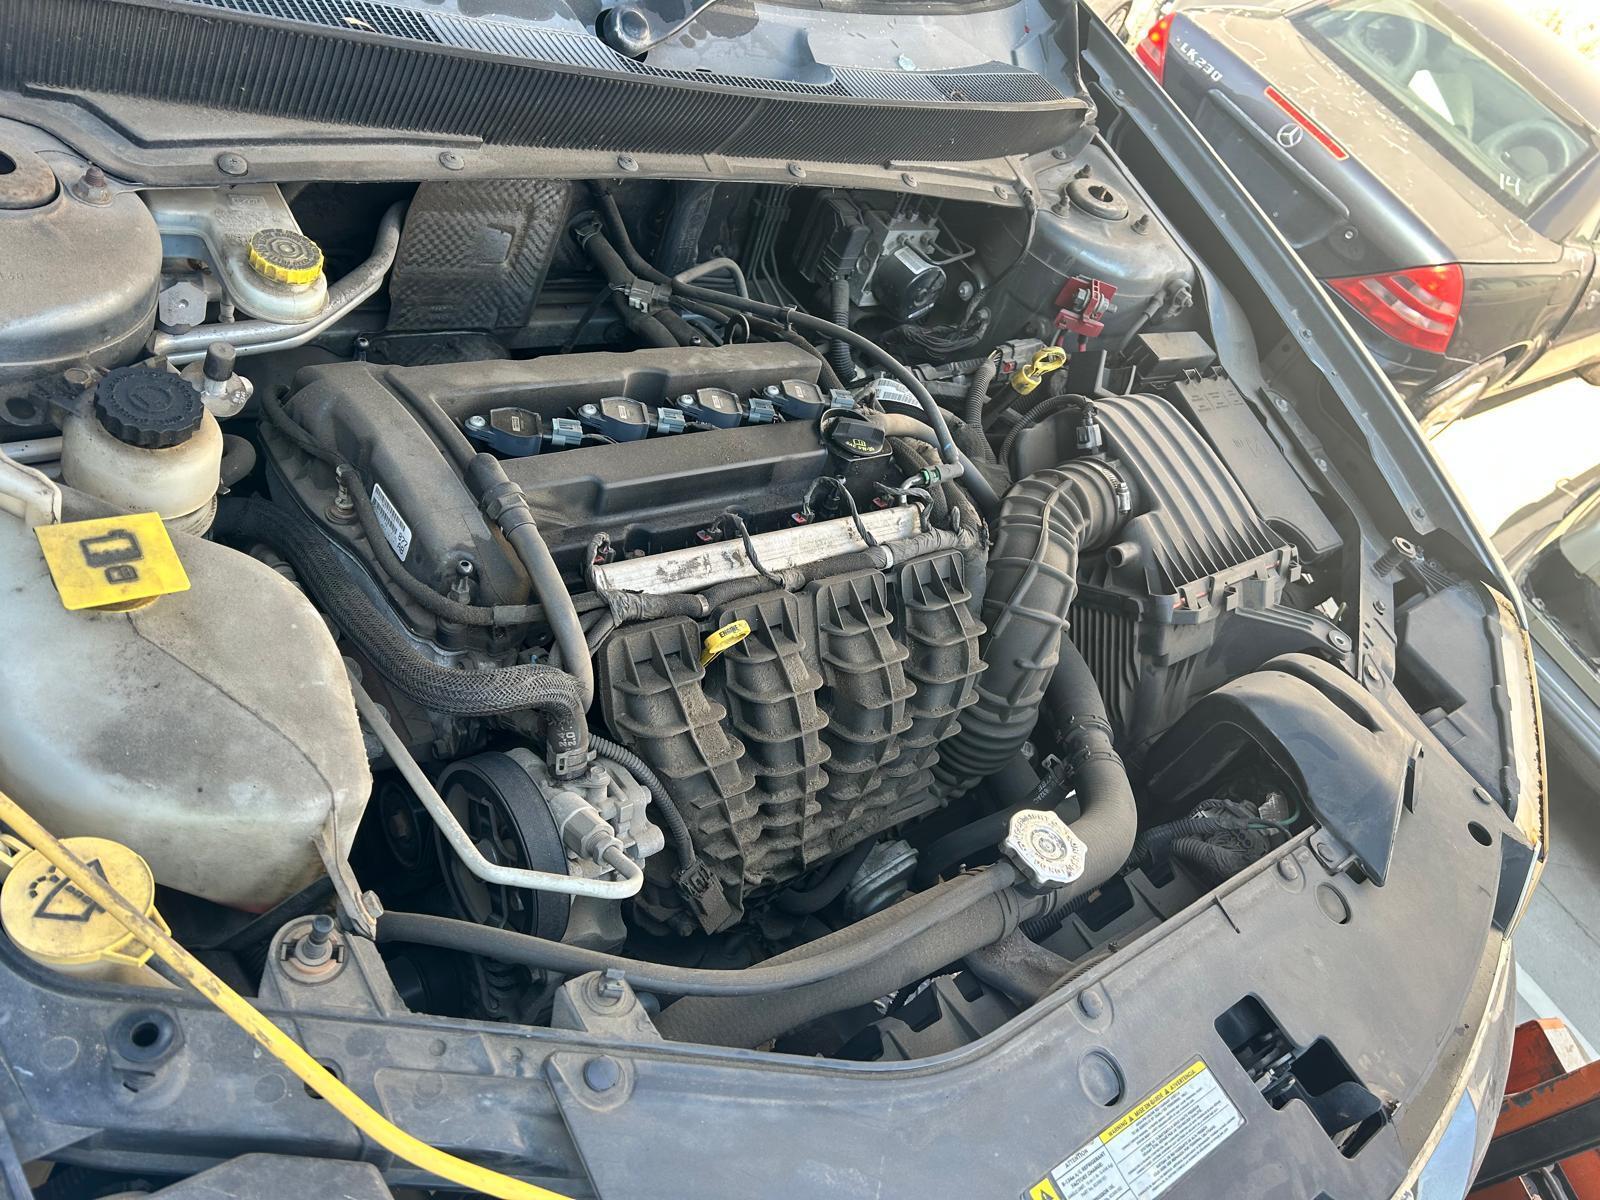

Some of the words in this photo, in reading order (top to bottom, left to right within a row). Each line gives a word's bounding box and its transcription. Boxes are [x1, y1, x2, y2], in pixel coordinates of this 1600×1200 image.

[1499, 172, 1521, 196] 14
[566, 731, 577, 747] 2.0
[1108, 1119, 1128, 1137] WARNING
[1064, 1148, 1089, 1168] ATTENTION
[1081, 1151, 1106, 1171] REFRIGERANT
[1071, 1173, 1088, 1188] FACTORY
